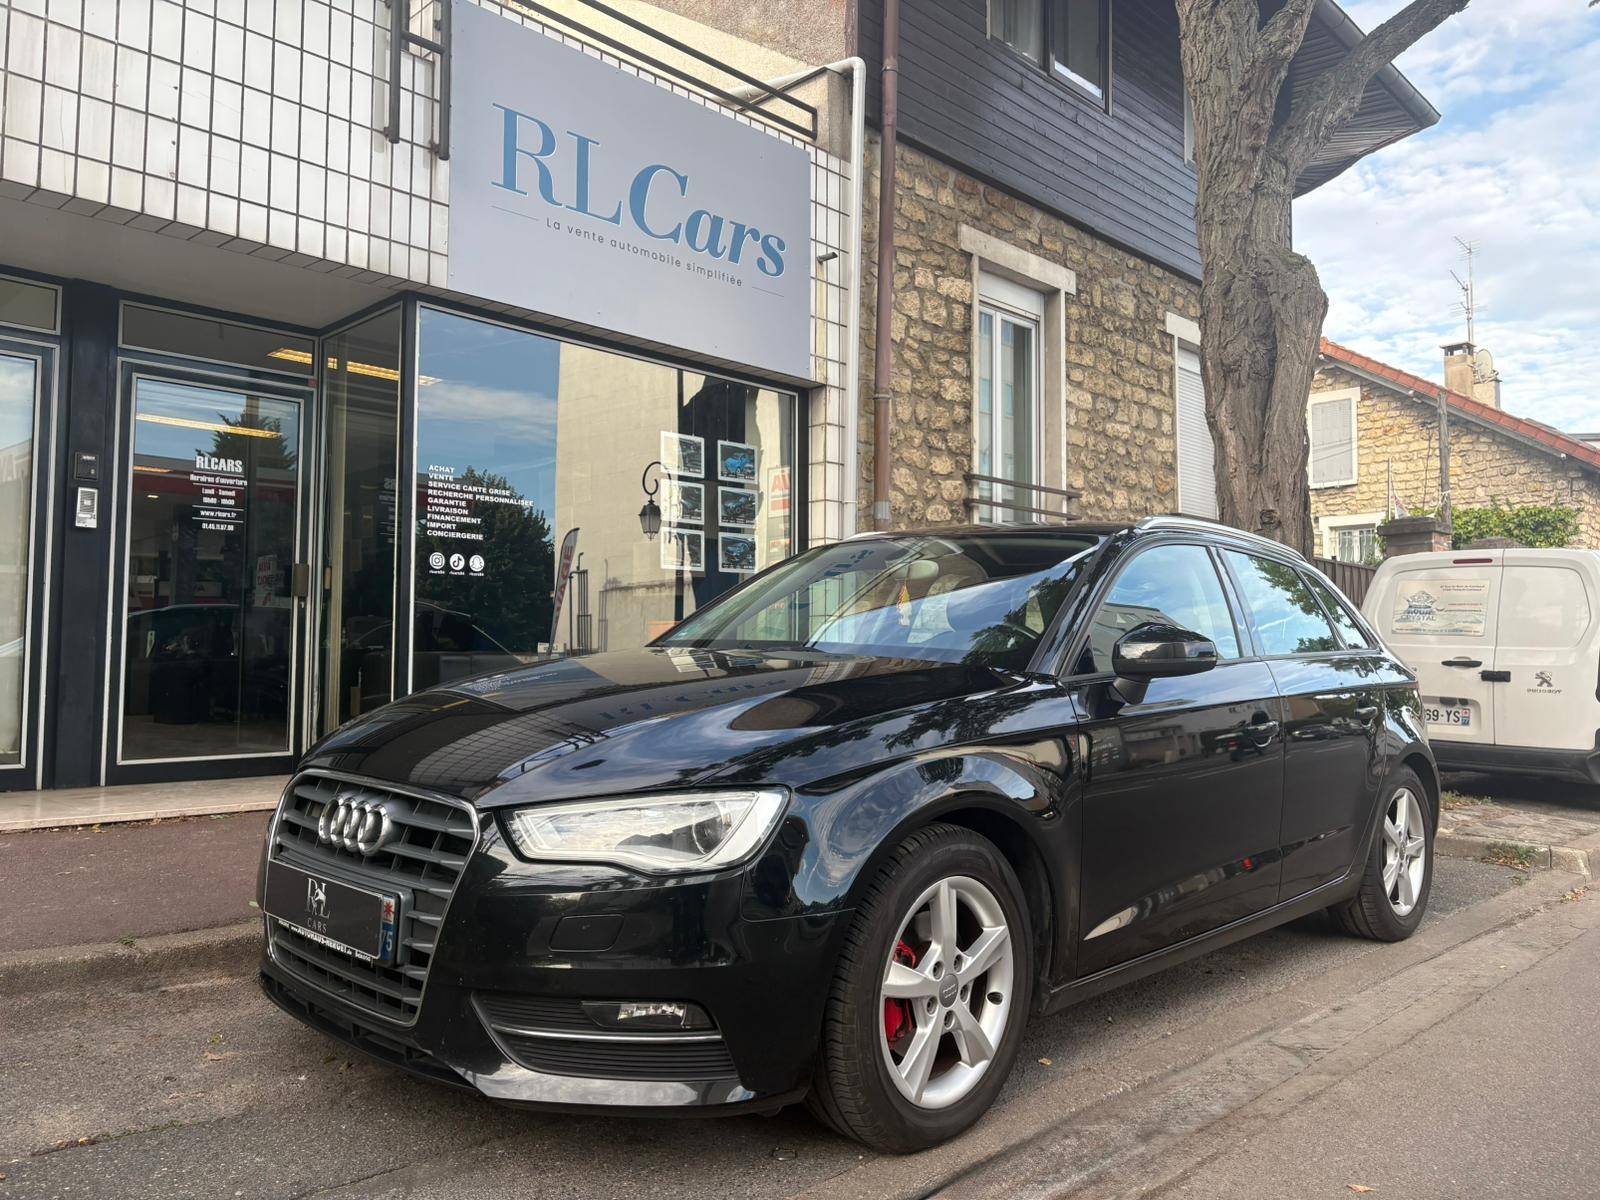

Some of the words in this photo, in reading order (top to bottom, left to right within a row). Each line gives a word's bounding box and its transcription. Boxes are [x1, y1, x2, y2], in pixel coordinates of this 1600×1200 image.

[546, 217, 561, 231] La
[567, 226, 605, 244] vente
[610, 237, 682, 268] automobile
[686, 260, 743, 287] simplifiée
[195, 456, 243, 473] RLCARS
[428, 465, 455, 474] ACHAT
[428, 473, 454, 482] VENTE
[427, 488, 474, 500] RECHERCHE
[428, 481, 461, 490] SERVICE
[462, 485, 487, 493] CARTE
[488, 488, 511, 496] GRISE
[427, 497, 467, 507] GARANTIE
[427, 505, 469, 515] LIVRAISON
[427, 513, 482, 525] FINANCEMENT
[427, 521, 456, 530] IMPORT
[426, 529, 484, 541] CONCIERGERIE
